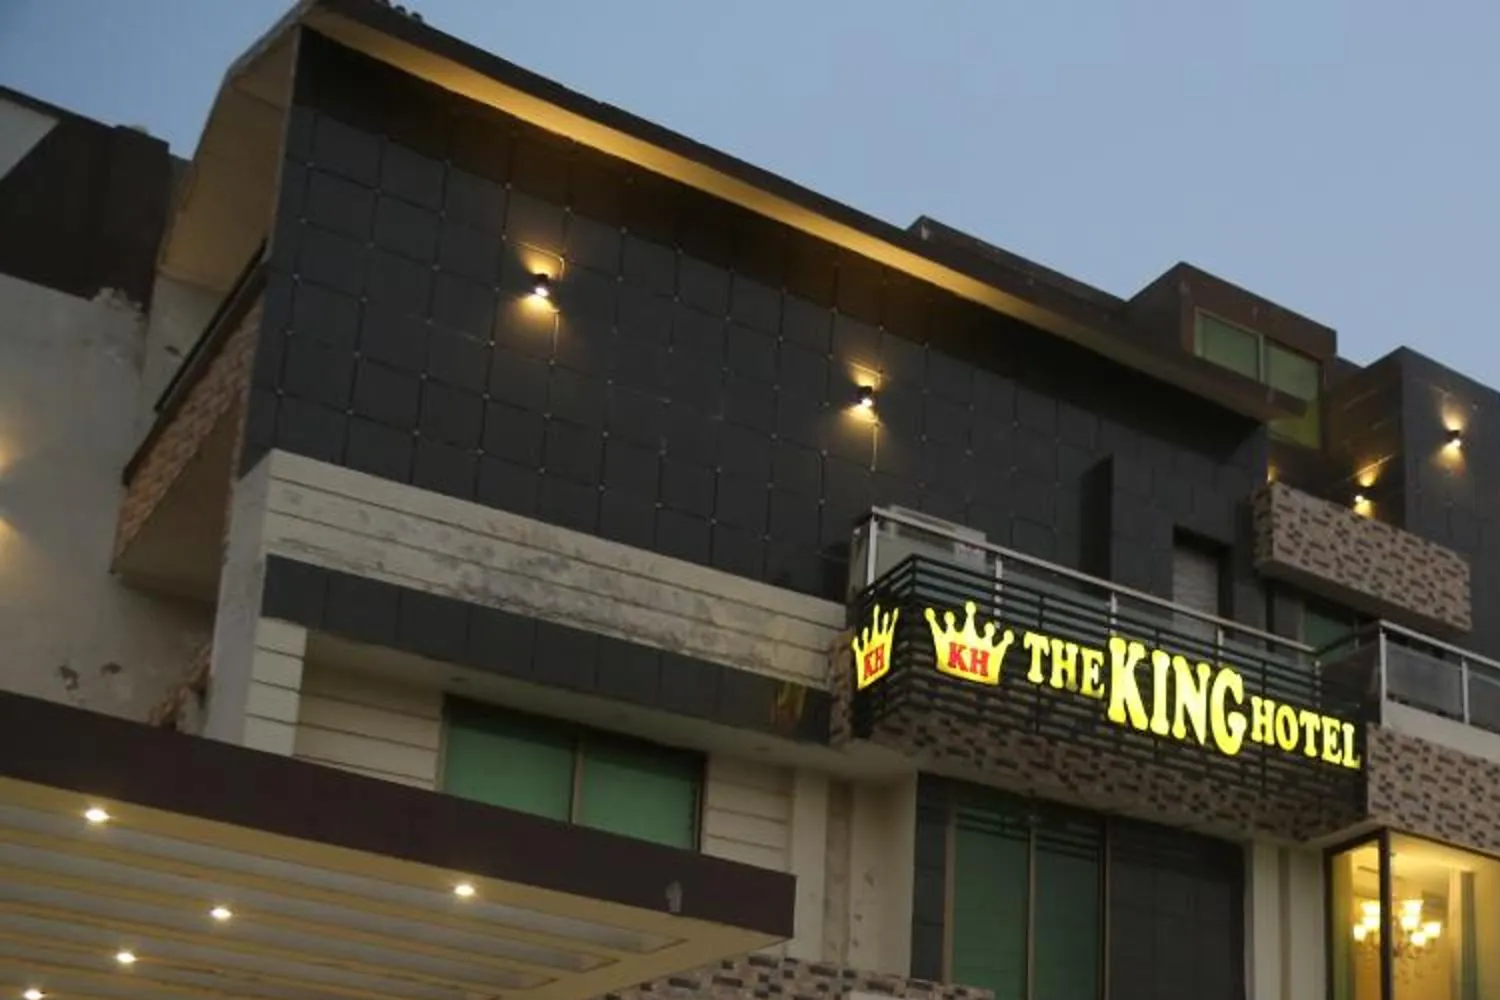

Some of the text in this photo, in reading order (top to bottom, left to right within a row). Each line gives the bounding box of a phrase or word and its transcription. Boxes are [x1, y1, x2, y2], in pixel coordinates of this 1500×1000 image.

[862, 643, 886, 679] KH
[947, 641, 990, 677] KH
[1024, 632, 1361, 769] THE KING HOTEL
